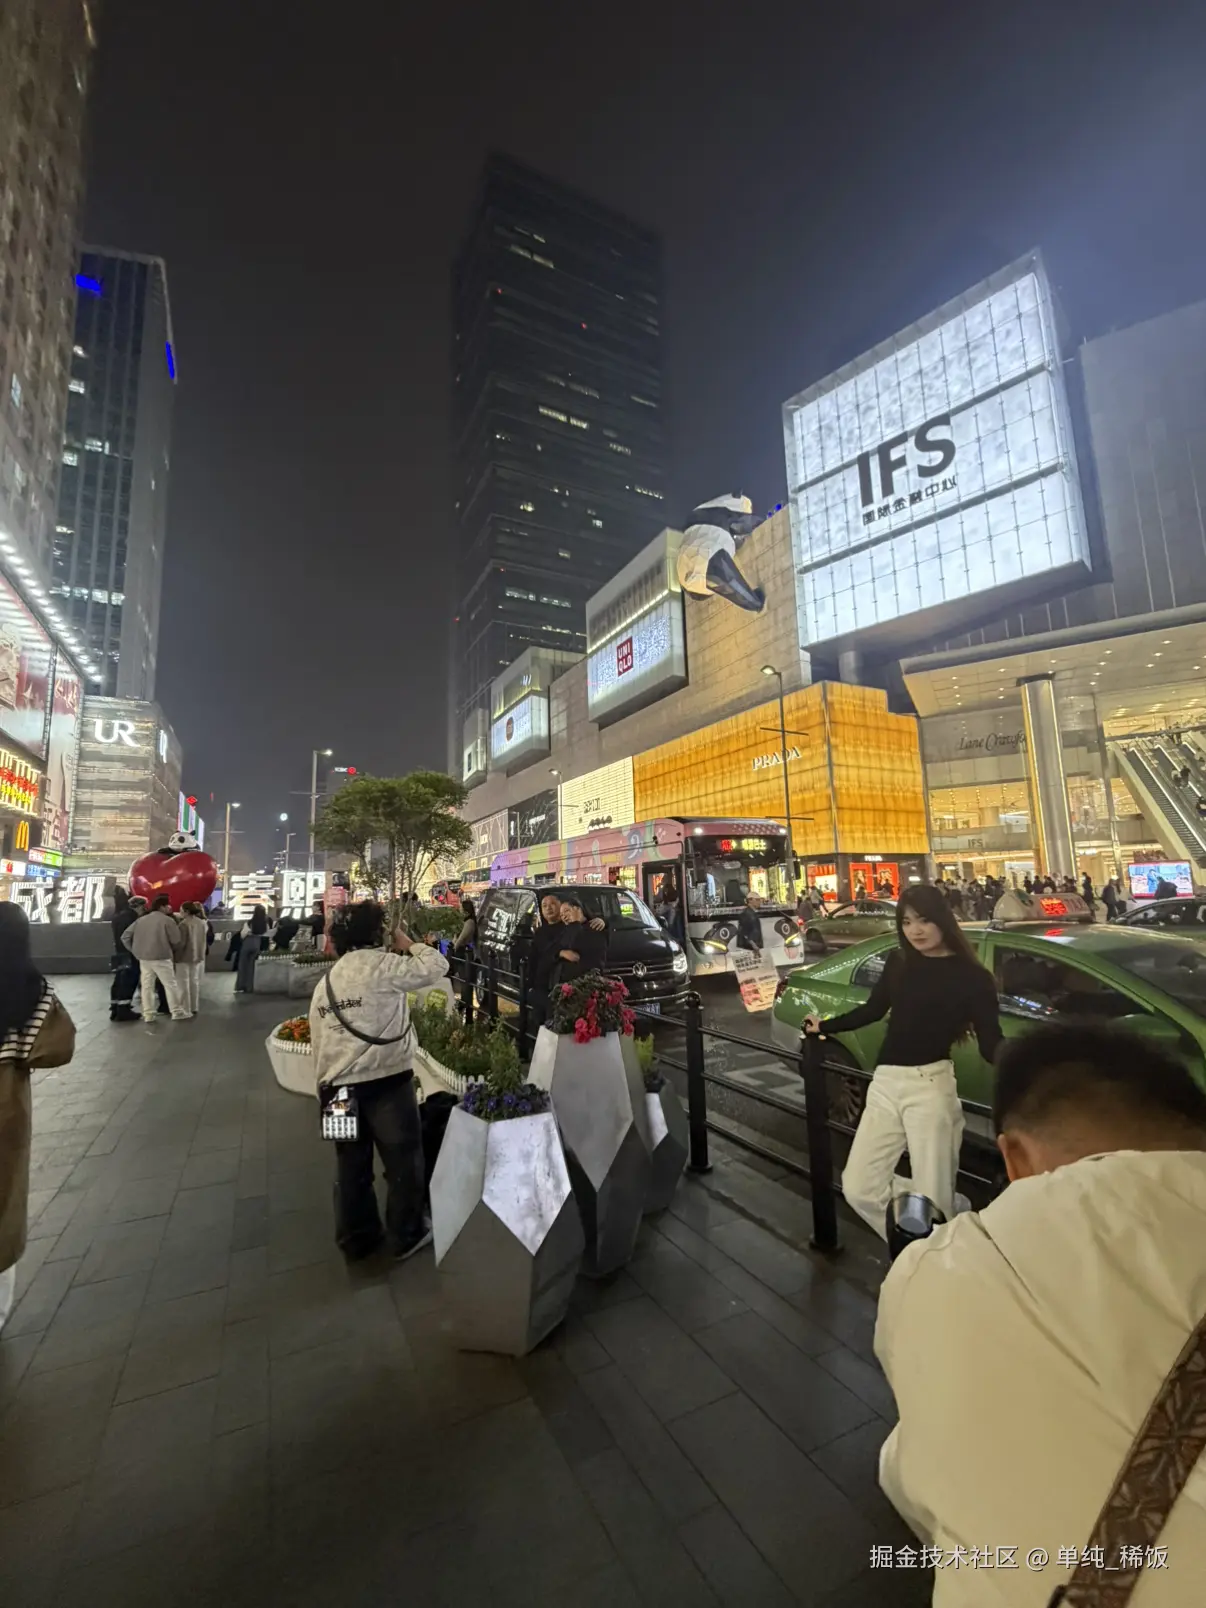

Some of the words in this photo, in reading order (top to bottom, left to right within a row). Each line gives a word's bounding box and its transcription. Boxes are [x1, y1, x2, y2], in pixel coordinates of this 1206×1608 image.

[857, 412, 956, 508] IFS
[618, 642, 631, 659] UNI
[618, 654, 632, 673] QLO
[94, 719, 141, 747] UR
[752, 746, 802, 771] PRADA
[968, 838, 983, 848] IFS
[10, 876, 105, 923] 成都
[228, 872, 326, 921] 春熙
